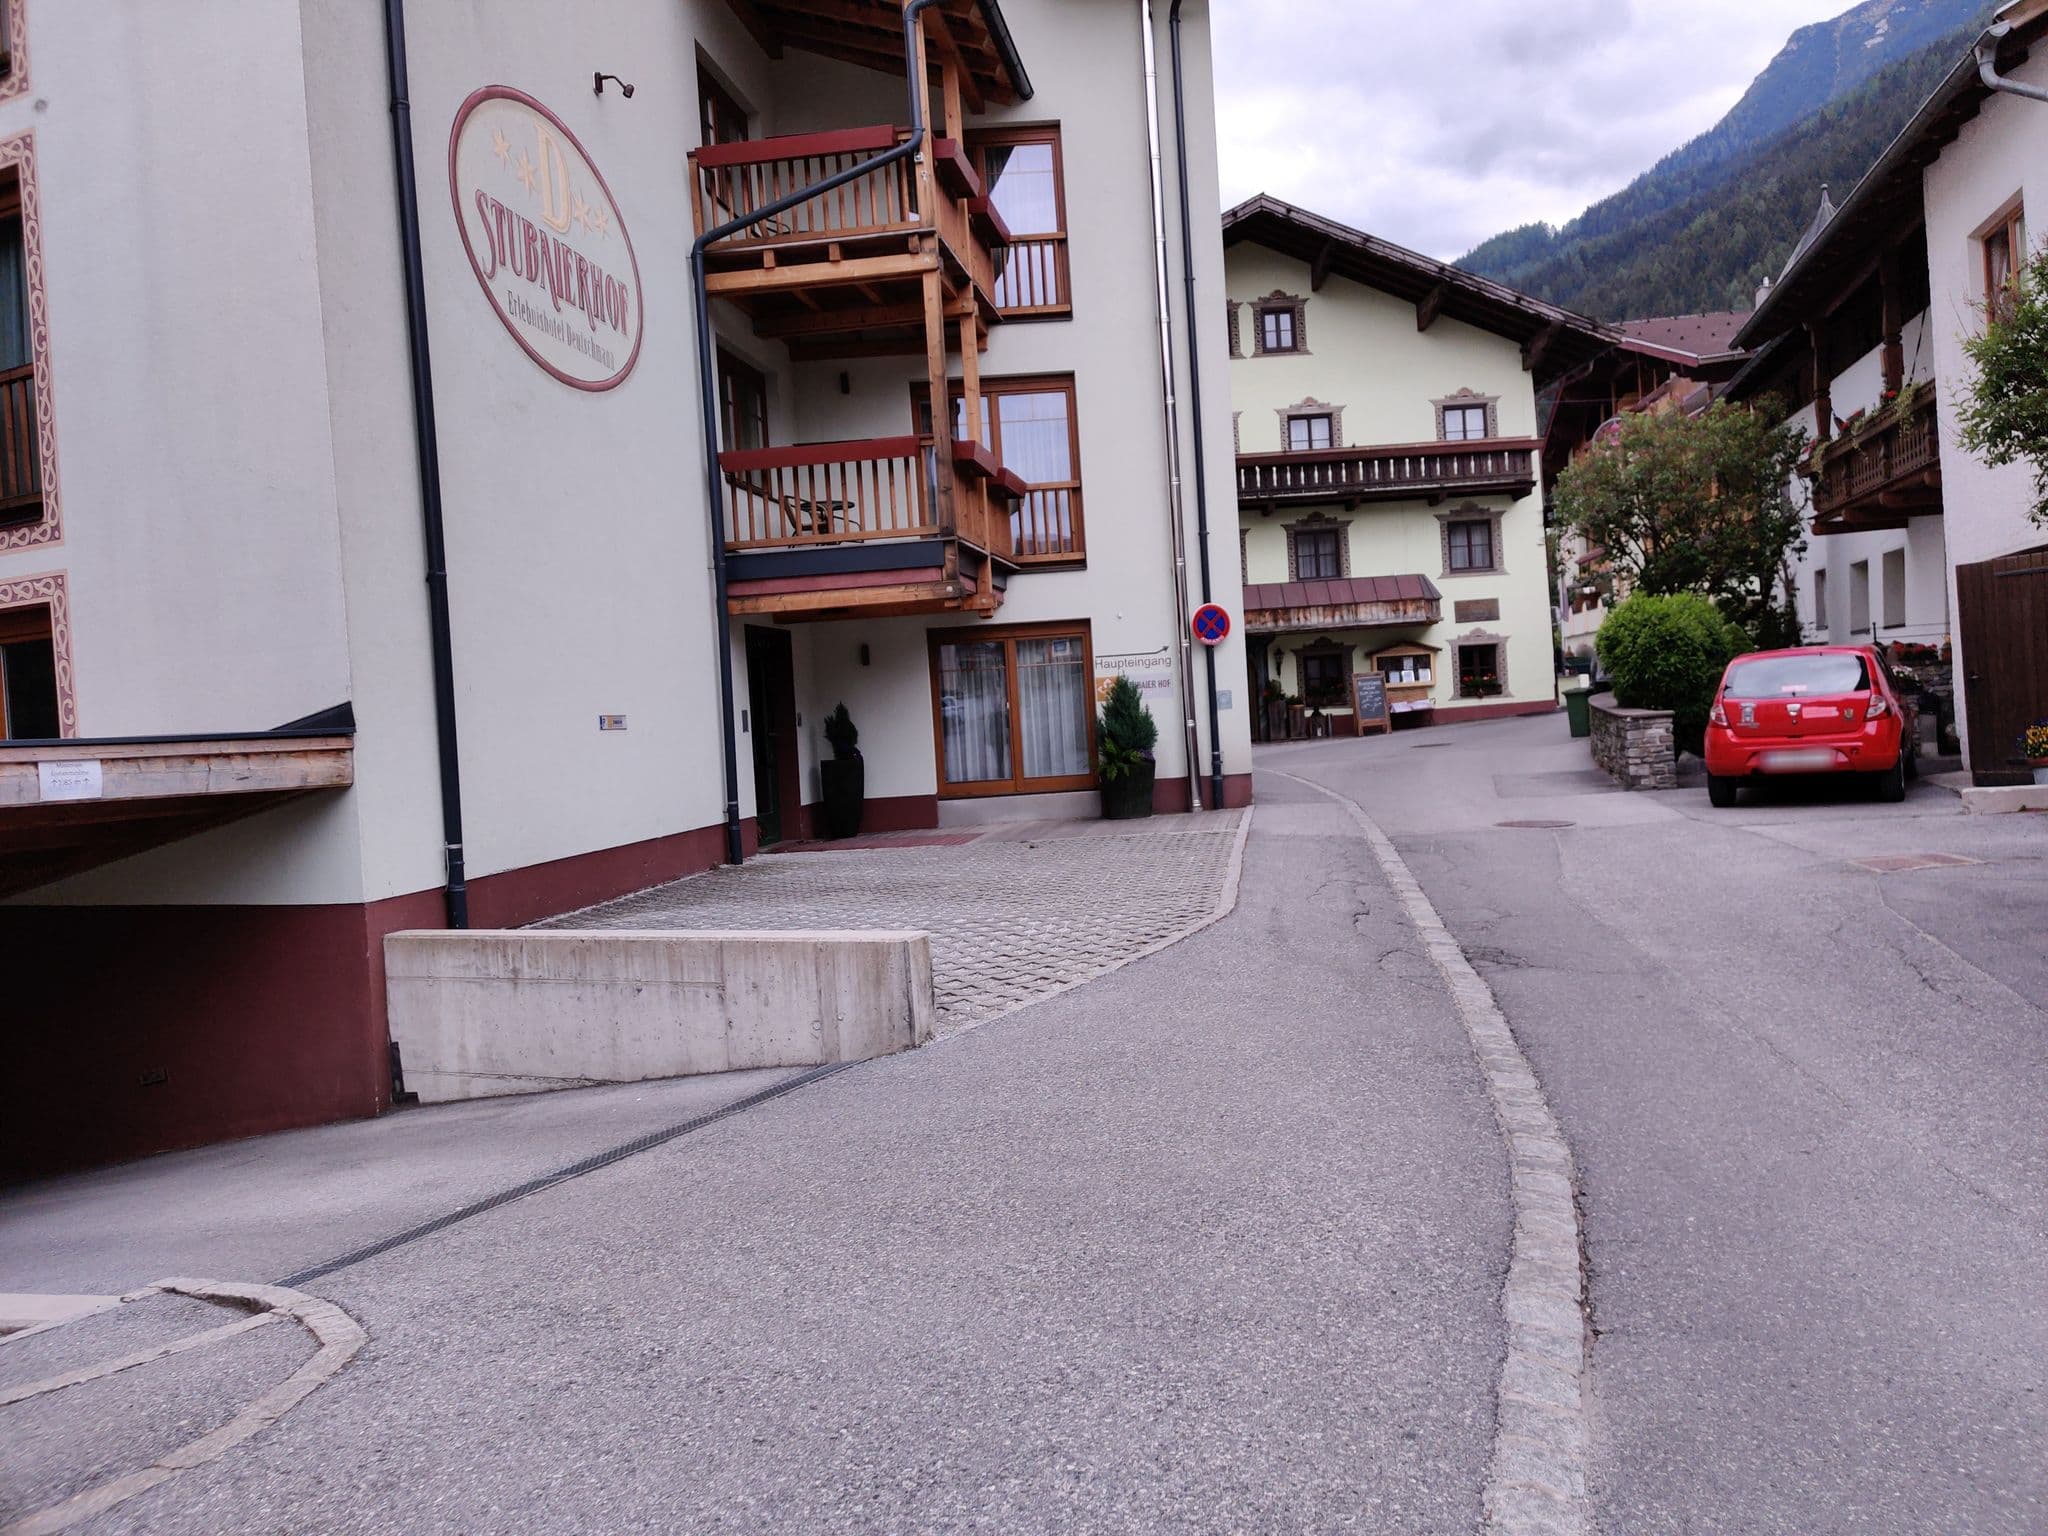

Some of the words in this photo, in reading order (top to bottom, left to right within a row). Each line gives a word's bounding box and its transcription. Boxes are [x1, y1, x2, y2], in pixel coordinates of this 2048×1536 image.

[533, 122, 571, 234] D
[475, 189, 629, 336] STUBAIERHOF
[507, 289, 565, 342] Erlebnishotel
[1095, 657, 1172, 669] Haupteingang
